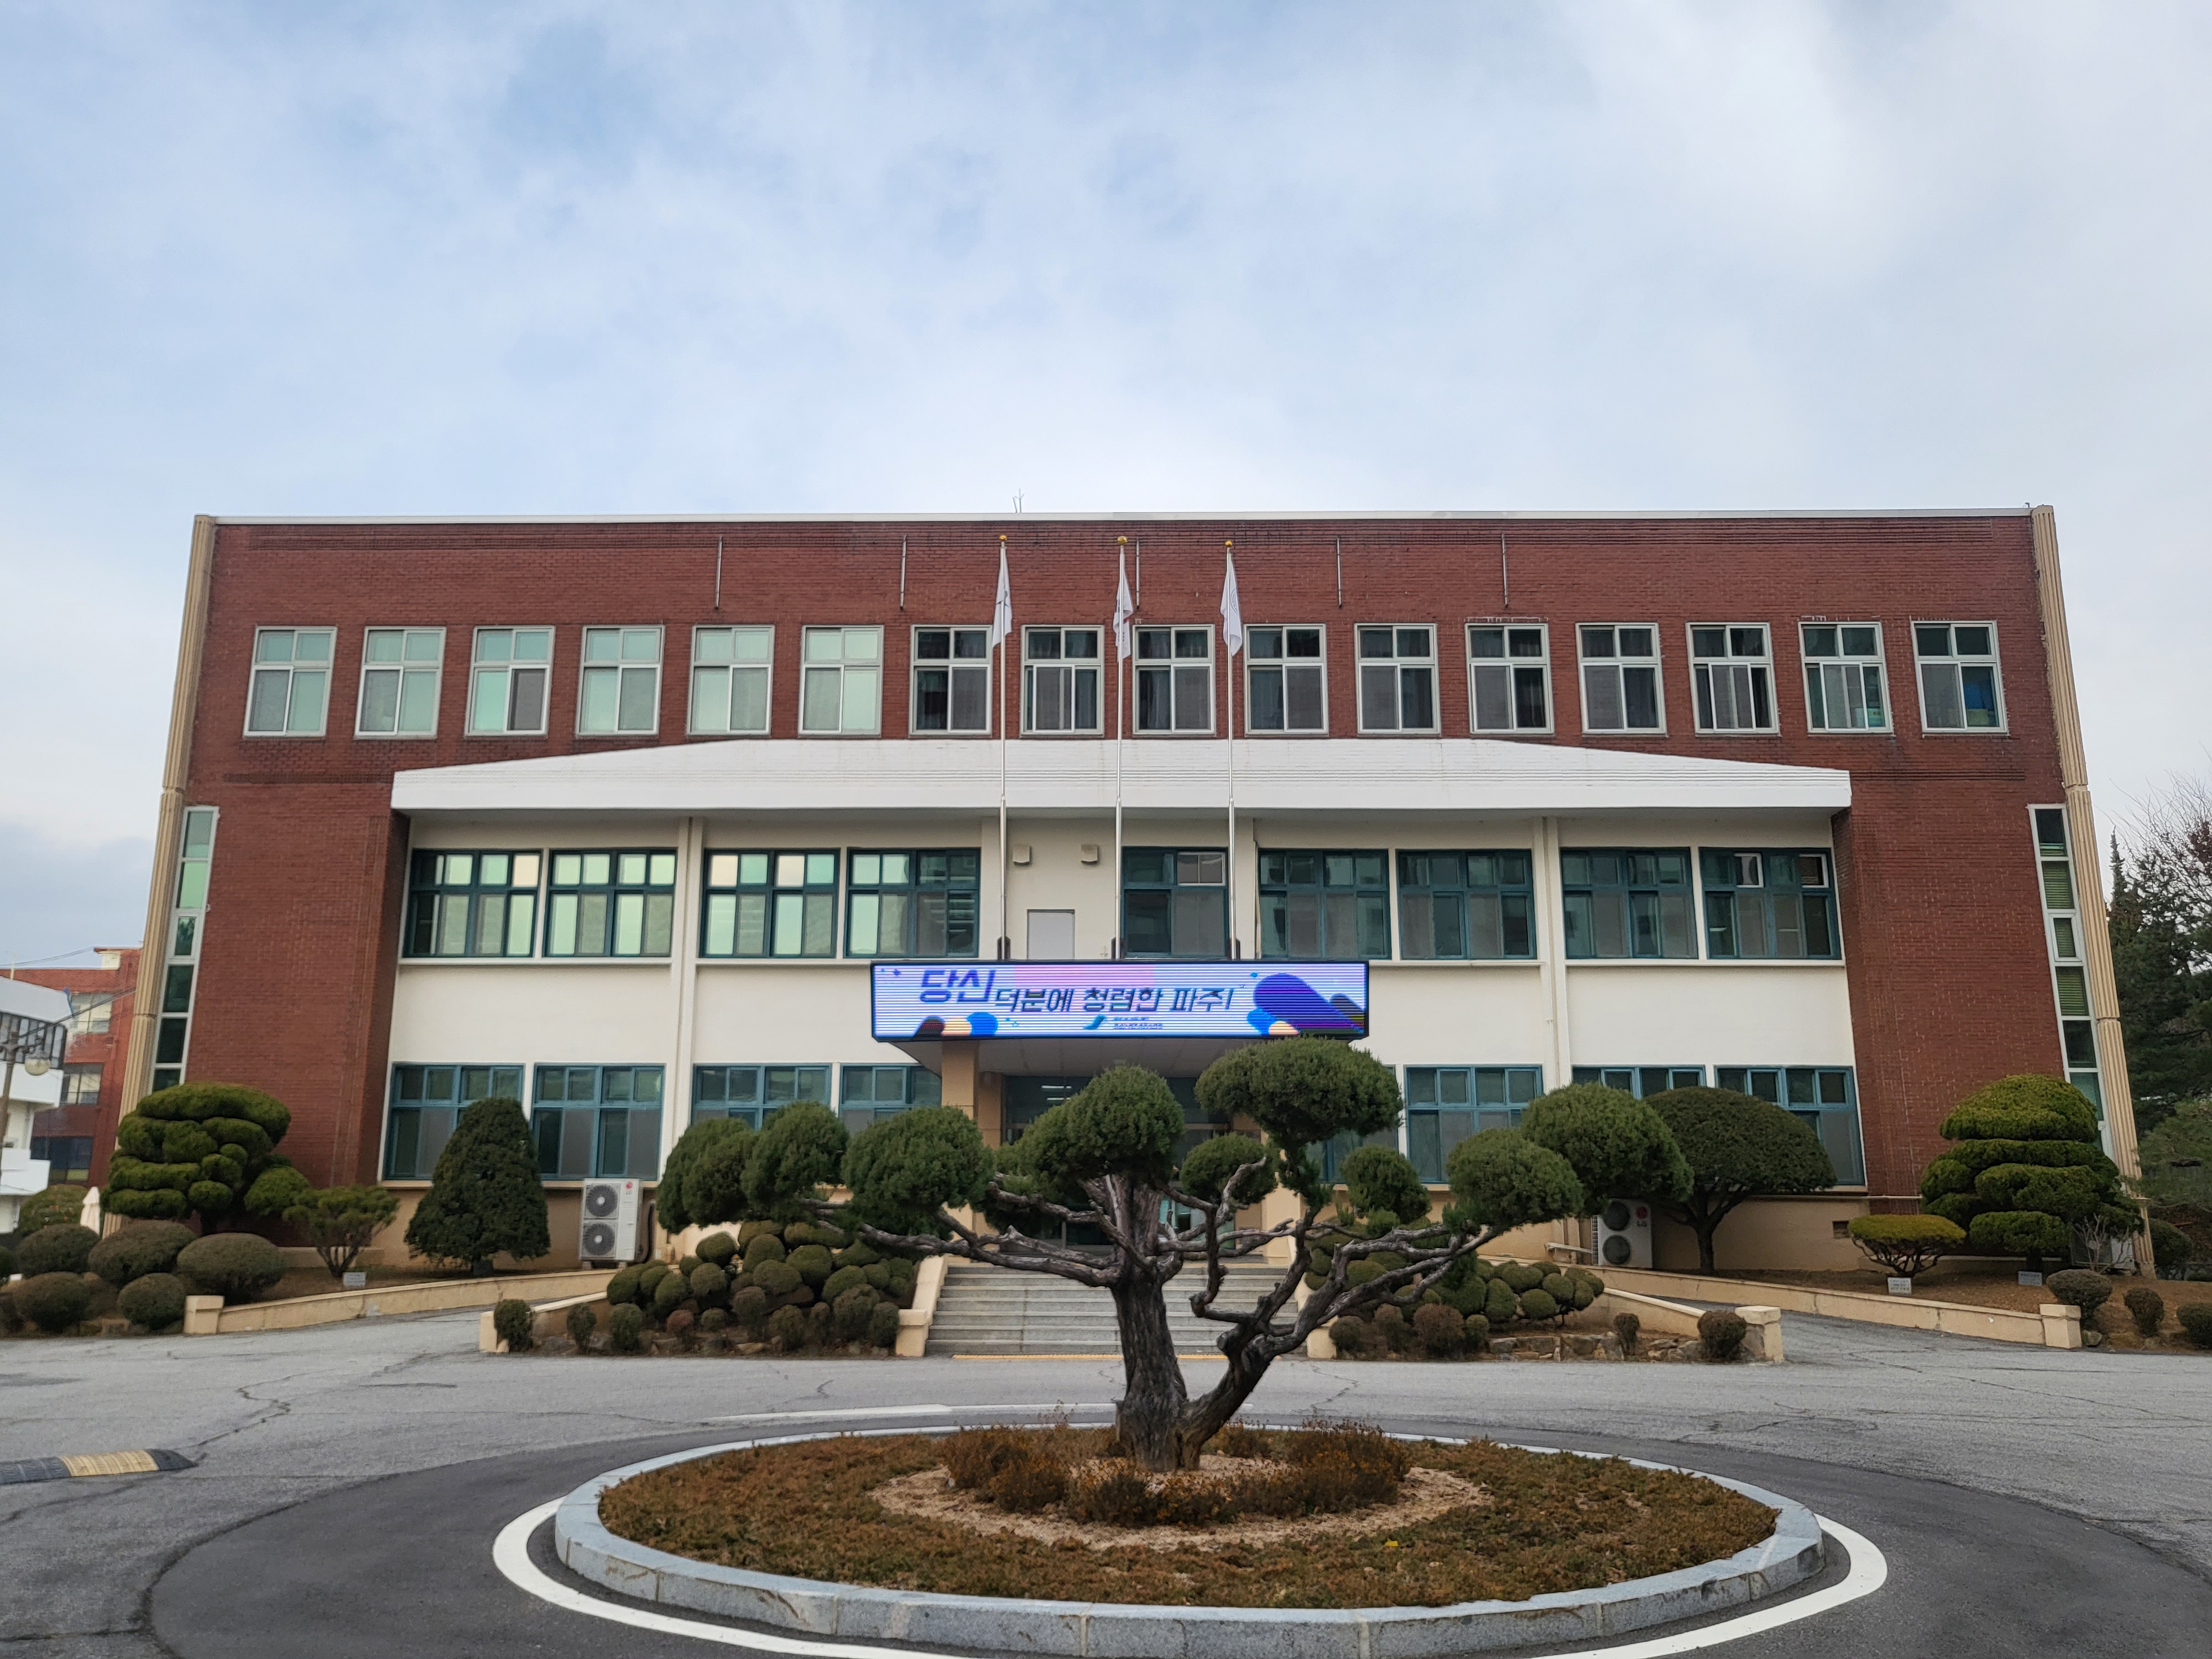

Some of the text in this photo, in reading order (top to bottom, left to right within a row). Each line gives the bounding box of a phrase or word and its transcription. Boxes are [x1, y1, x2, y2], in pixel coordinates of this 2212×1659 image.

[920, 969, 995, 1002] 당신
[995, 988, 1074, 1012] 덕분에
[1083, 987, 1161, 1012] 청렴한
